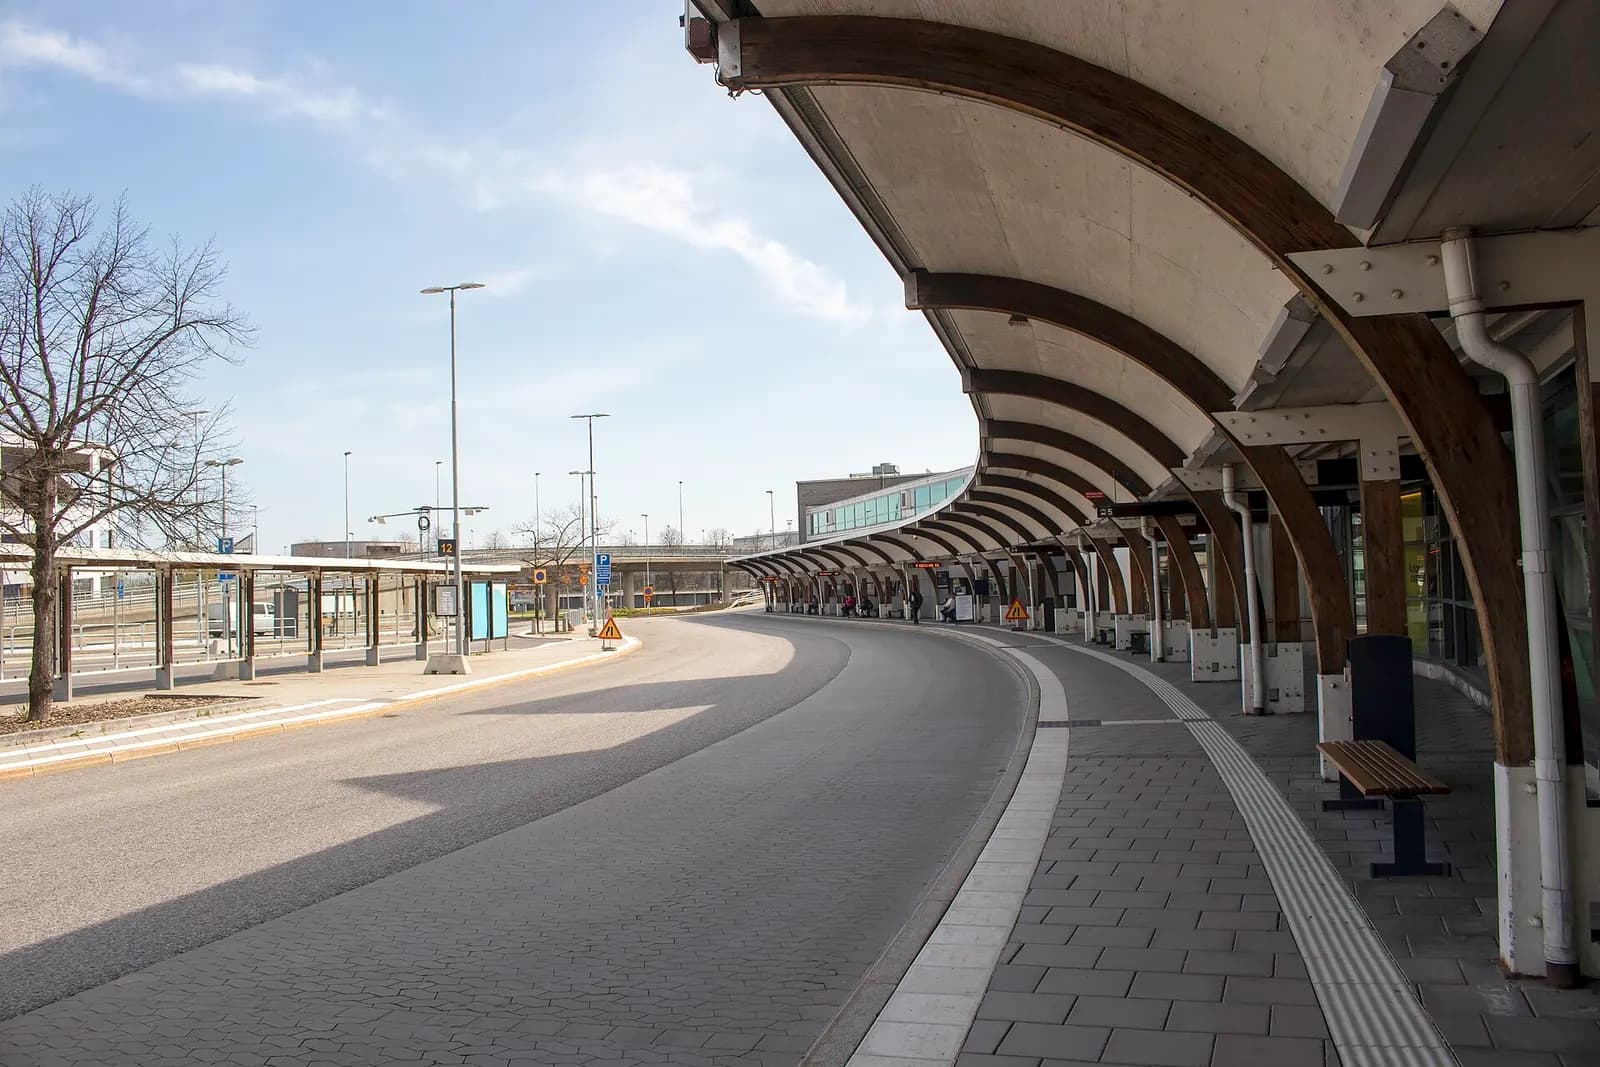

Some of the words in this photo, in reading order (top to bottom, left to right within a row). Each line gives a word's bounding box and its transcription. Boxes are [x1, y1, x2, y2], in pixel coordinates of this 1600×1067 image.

[222, 539, 231, 553] P
[440, 543, 453, 553] 12
[600, 555, 608, 565] P
